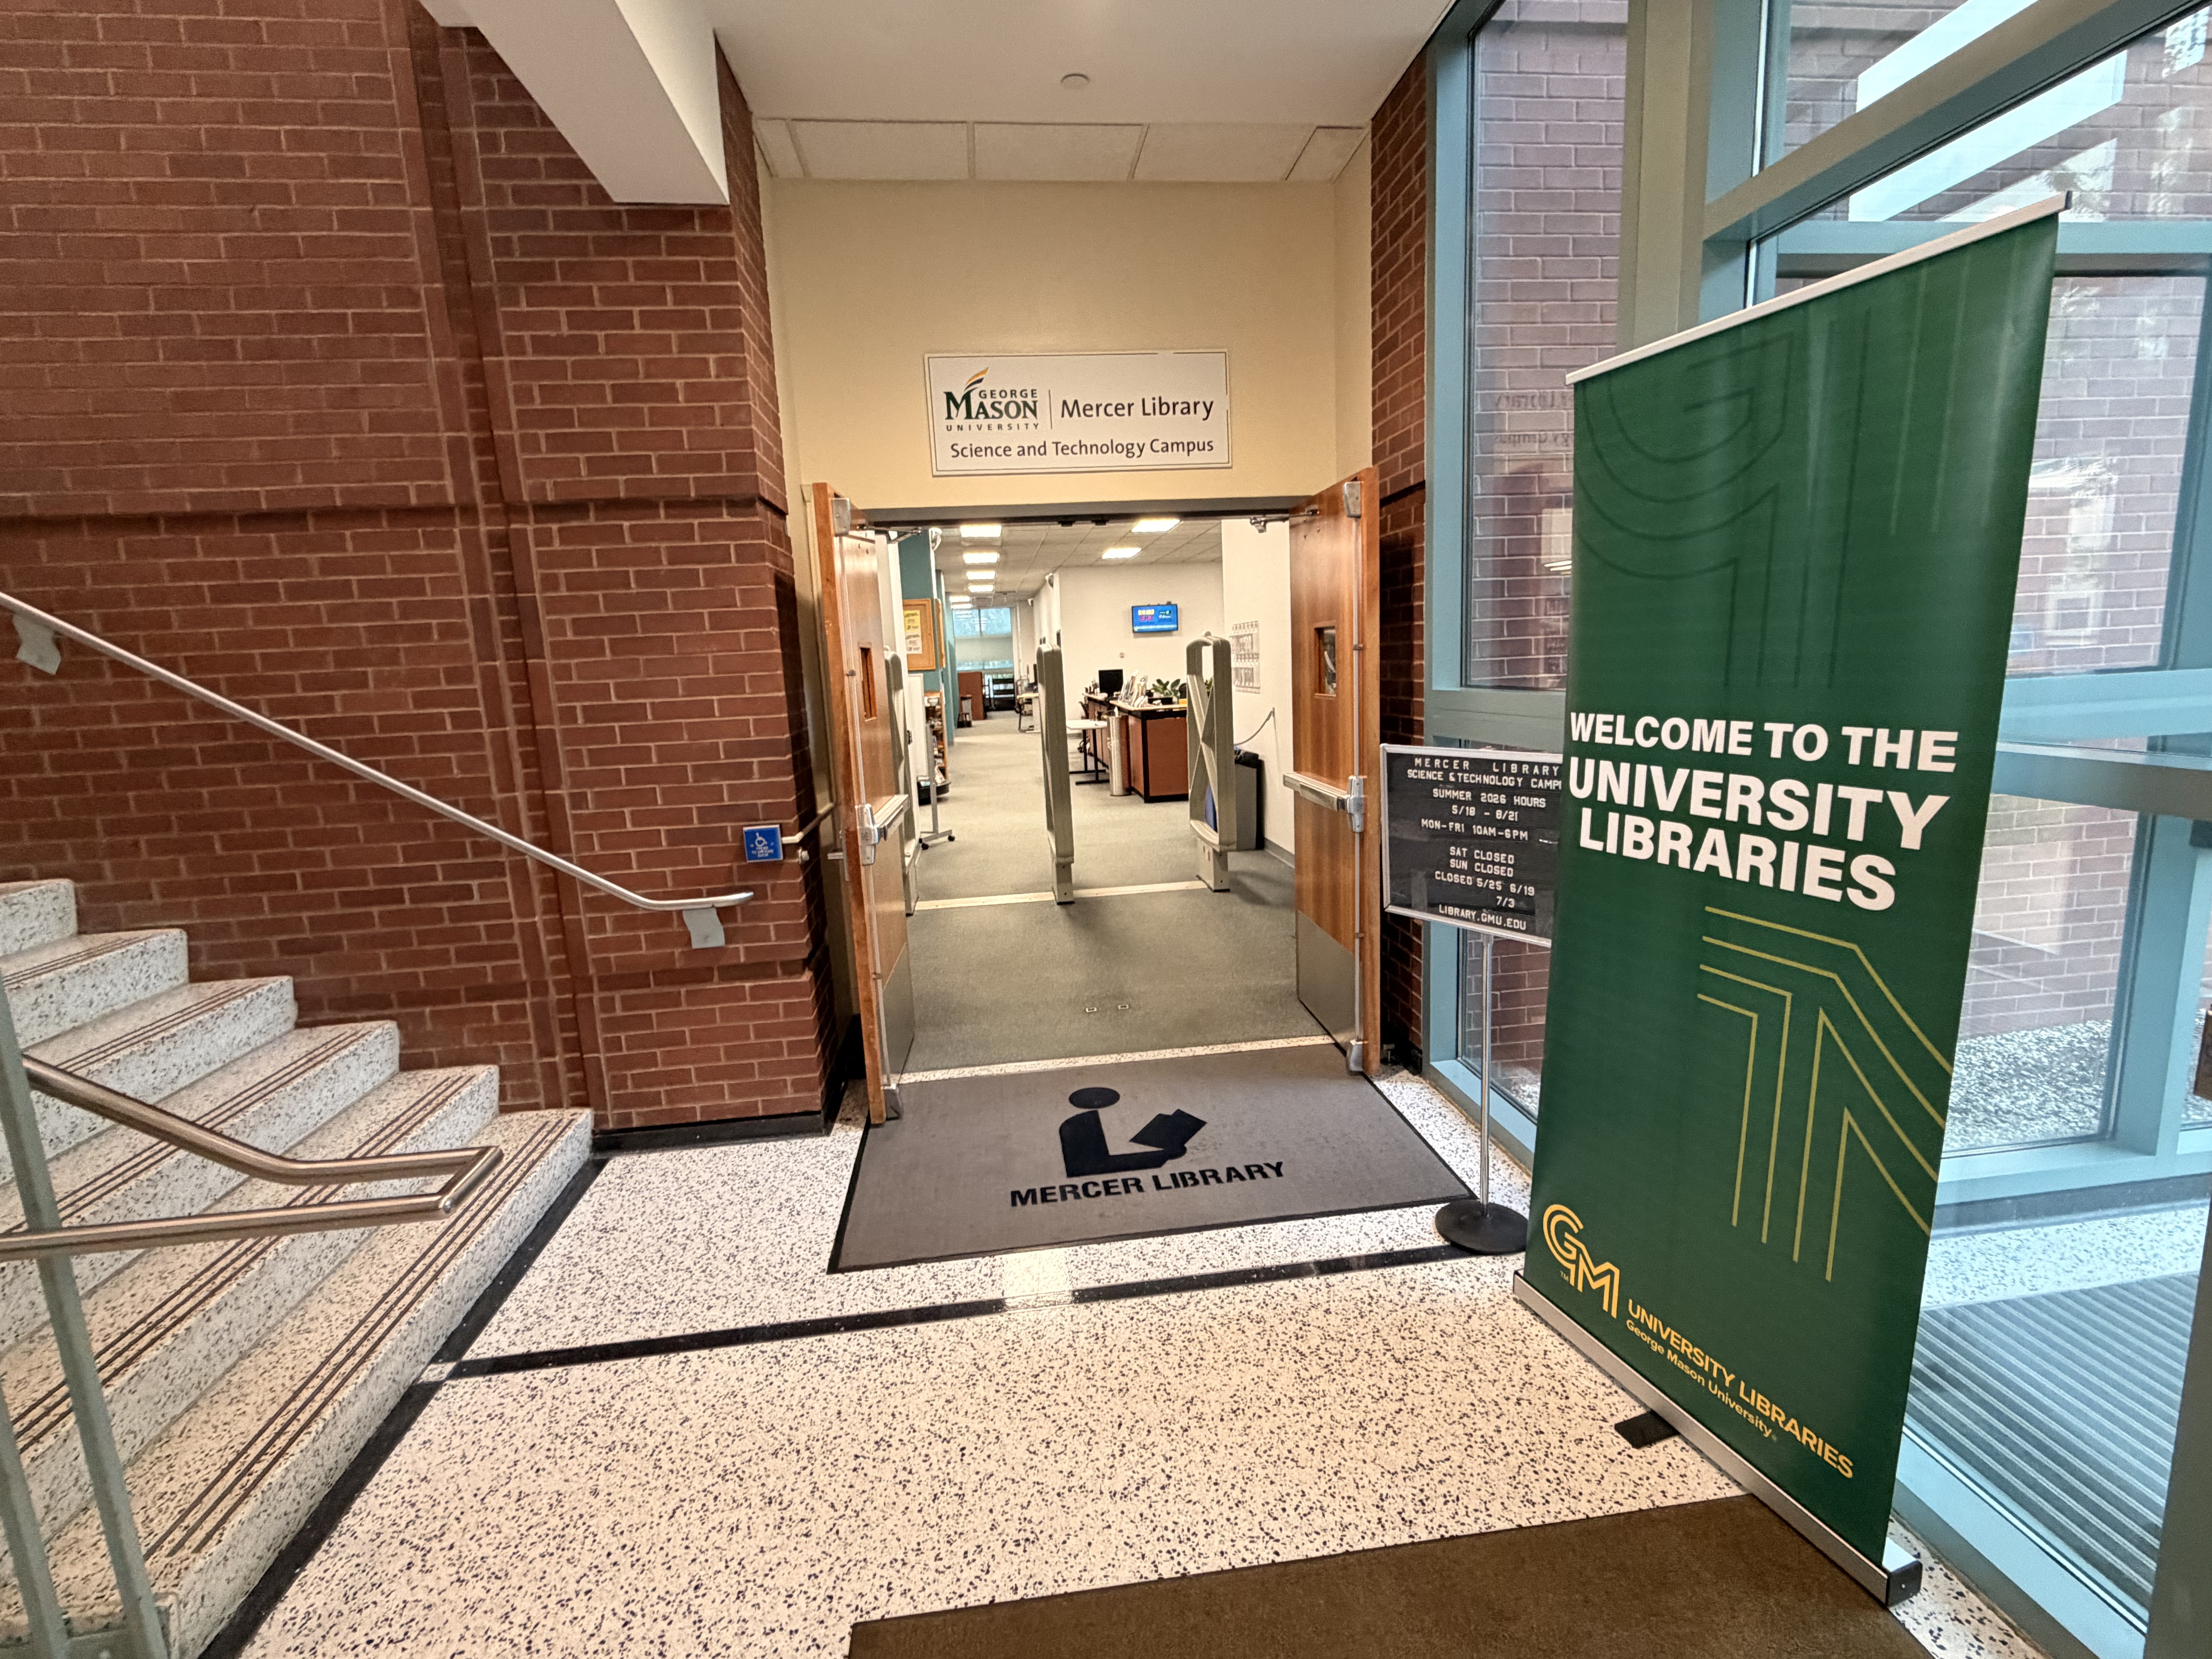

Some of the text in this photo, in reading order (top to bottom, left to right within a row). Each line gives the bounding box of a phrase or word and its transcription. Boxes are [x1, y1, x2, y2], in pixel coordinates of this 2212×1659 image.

[943, 388, 1038, 420] MASON
[979, 389, 1037, 398] GEORGE
[1061, 397, 1214, 421] Mercer Library
[946, 423, 1039, 431] UNIVERSITY
[951, 438, 1213, 458] Science and Technology Campus
[1571, 713, 1958, 772] WELCOME TO THE
[1407, 769, 1443, 781] SCIENCE
[1415, 758, 1559, 776] MERCER LIBRARY
[1433, 788, 1546, 808] SUMMER 2026 HOURS
[1570, 757, 1950, 850] UNIVERSITY
[1452, 805, 1475, 816] 5/18
[1496, 809, 1518, 821] 8/21
[1421, 819, 1528, 840] MON-FRI 10AM-6PM
[1450, 847, 1514, 864] SAT CLOSED
[1580, 808, 1896, 911] LIBRARIES
[1450, 859, 1513, 877] SUN CLOSED
[1435, 871, 1535, 896] CLOSED 5/25 6/19
[1496, 896, 1515, 908] 7/3
[1439, 905, 1526, 930] LIBRARY.GMU.EDU
[1011, 1162, 1283, 1207] MERCER LIBRARY
[1626, 1319, 1772, 1437] George Mason University
[1628, 1298, 1853, 1479] UNIVERSITY LIBRARIES
